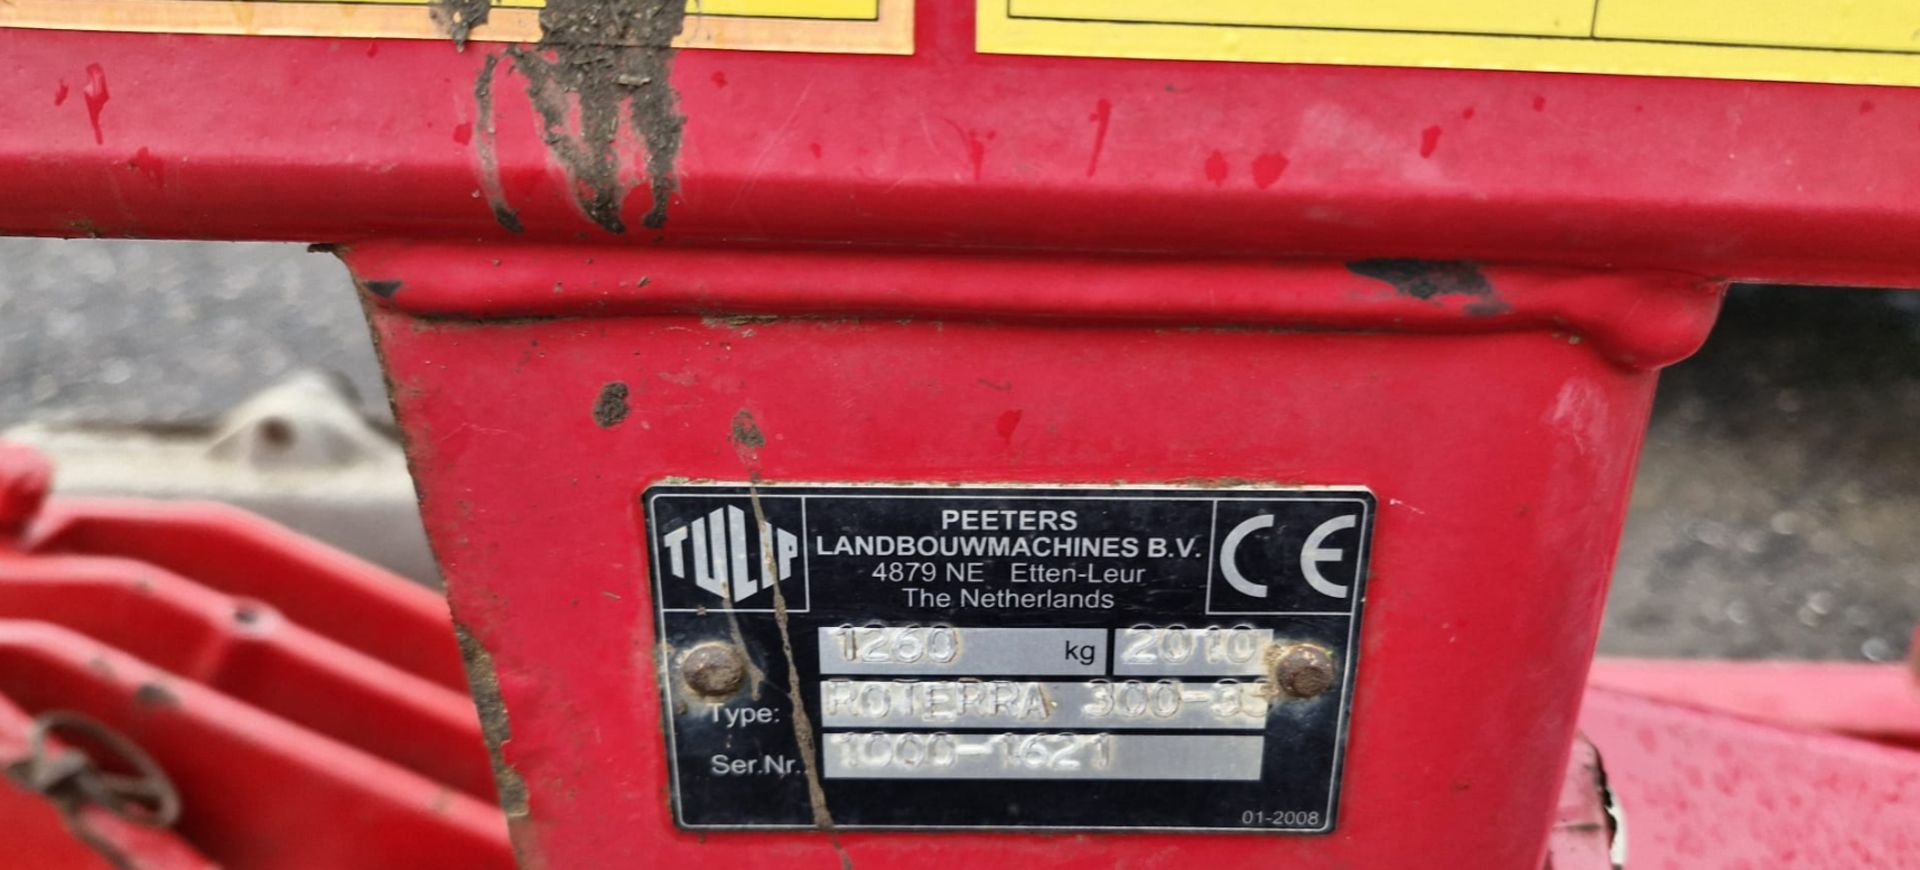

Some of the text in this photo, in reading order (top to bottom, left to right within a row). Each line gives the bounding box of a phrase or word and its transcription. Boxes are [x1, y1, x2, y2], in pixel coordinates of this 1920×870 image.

[941, 509, 1078, 531] PEETERS
[663, 504, 798, 602] TULIP
[816, 535, 1201, 558] LANDBOUWMACHINES B.V.
[872, 561, 1146, 584] 4879 NE Etten-Leur
[902, 587, 1115, 609] The Netherlands
[833, 624, 1096, 666] 1260 kg
[1121, 623, 1257, 665] 2010
[706, 702, 780, 728] Type:
[824, 677, 1050, 721] ROTERRA
[1242, 810, 1319, 825] 01-2008
